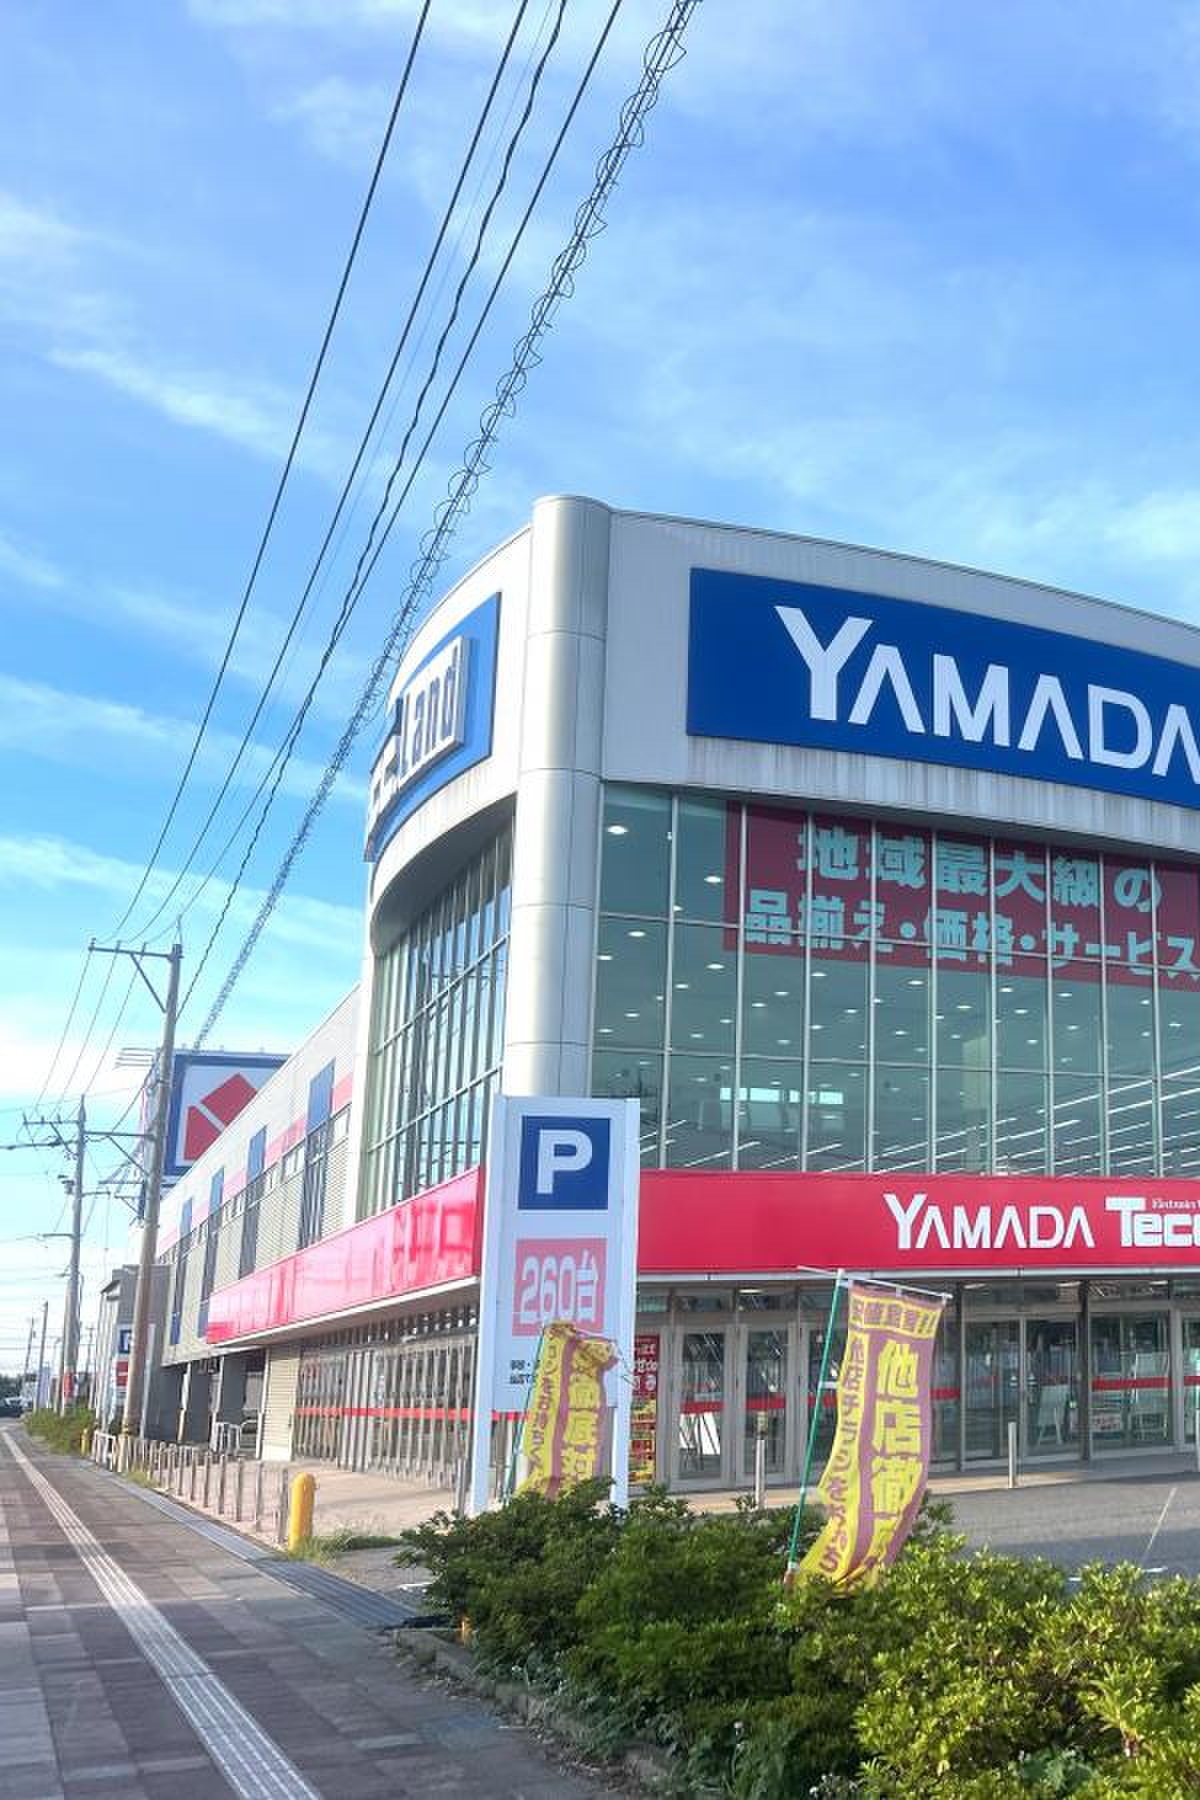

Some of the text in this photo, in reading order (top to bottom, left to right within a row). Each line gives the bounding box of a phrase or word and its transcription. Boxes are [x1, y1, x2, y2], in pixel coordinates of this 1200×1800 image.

[797, 824, 1163, 913] 地域最大級の
[536, 1129, 593, 1194] P
[883, 1193, 1096, 1250] YAMADA
[518, 1250, 599, 1325] 260台
